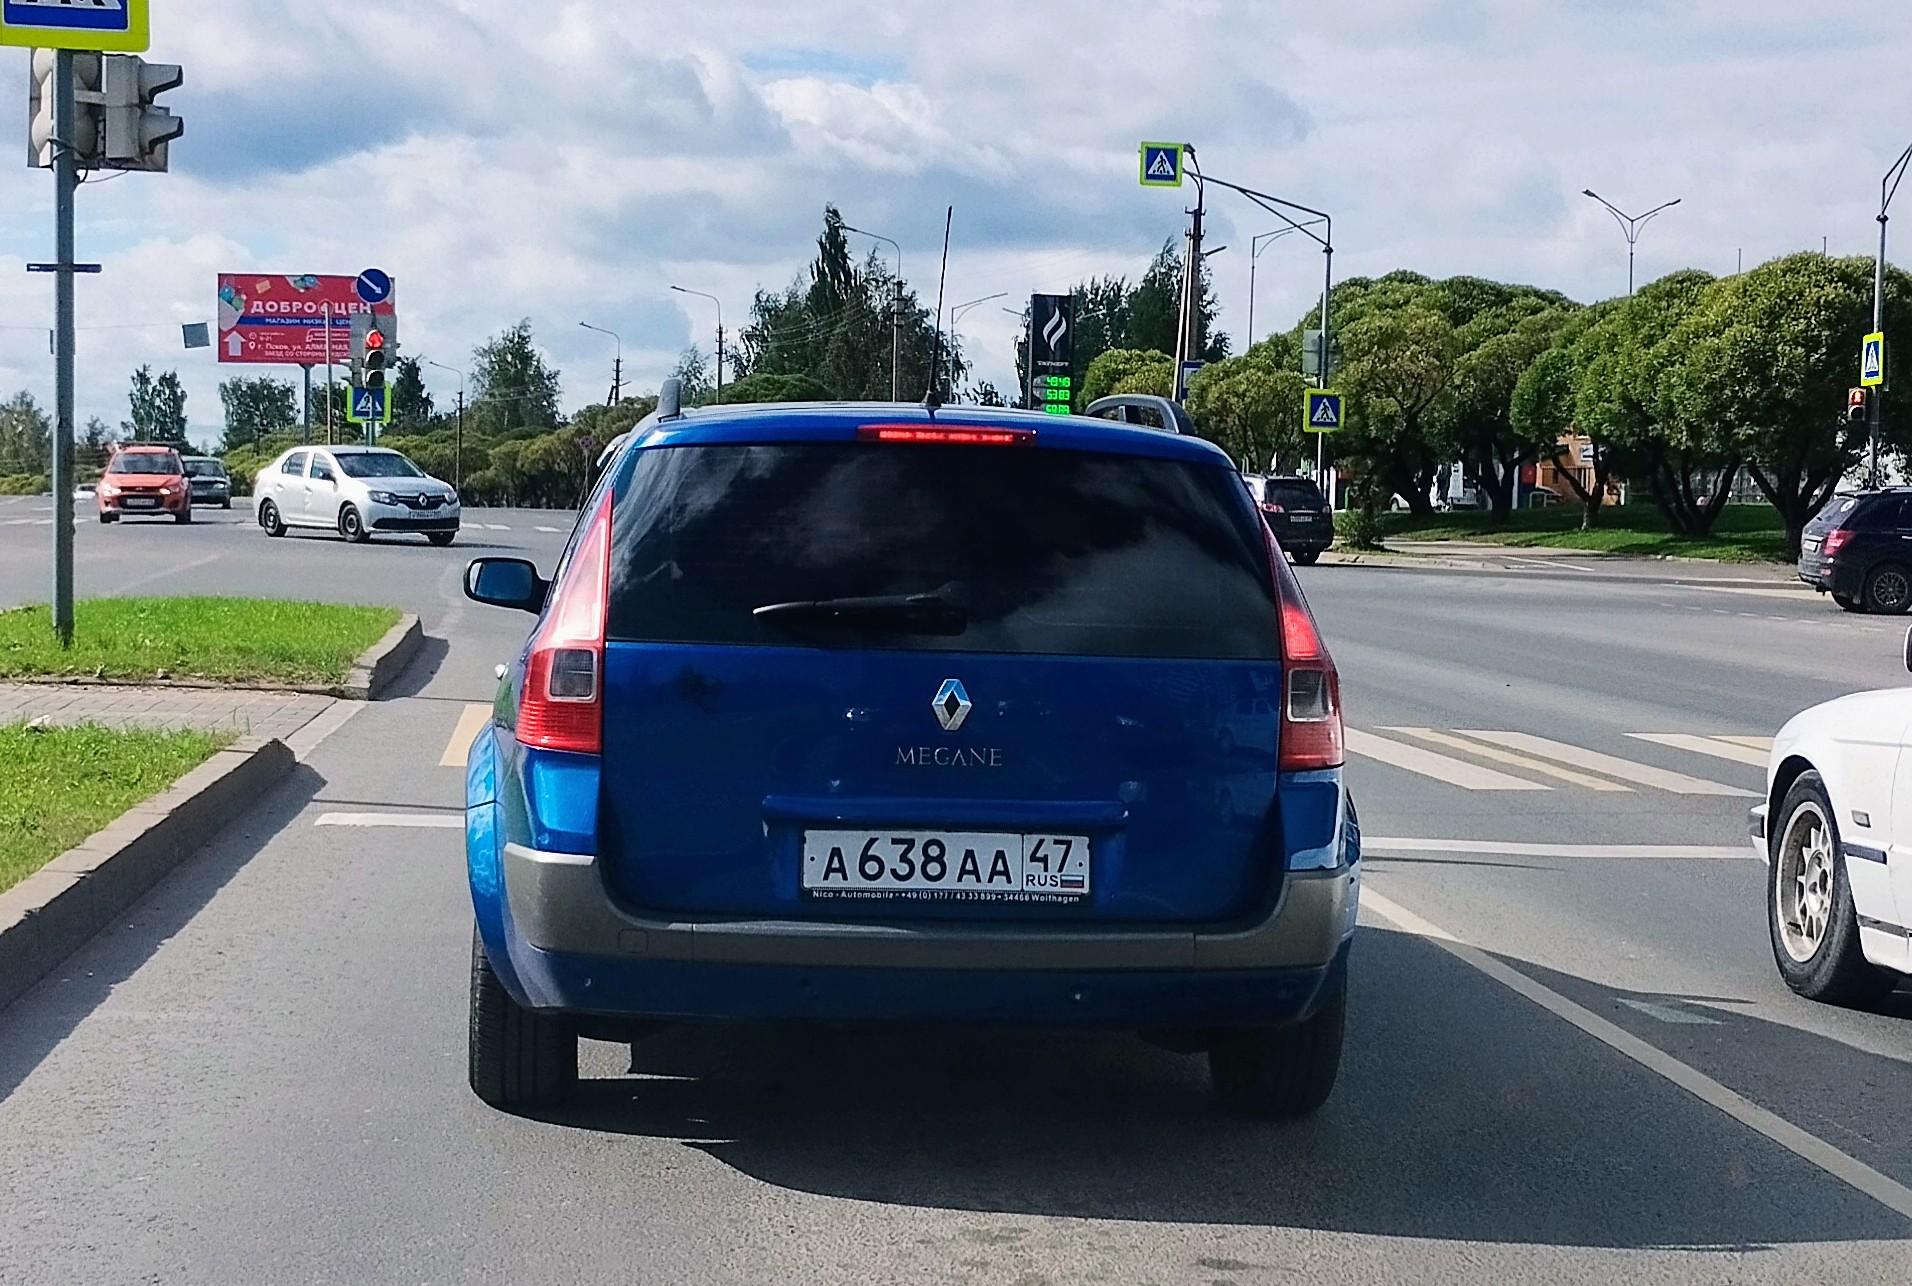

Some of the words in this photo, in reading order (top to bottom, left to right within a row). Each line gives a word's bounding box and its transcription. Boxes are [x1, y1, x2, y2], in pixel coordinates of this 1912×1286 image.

[265, 317, 301, 325] МАГАЗИН
[895, 746, 1003, 767] MEGANE
[1029, 838, 1073, 873] 47
[1025, 873, 1059, 887] RUS
[1031, 893, 1080, 904] Wolfhagen
